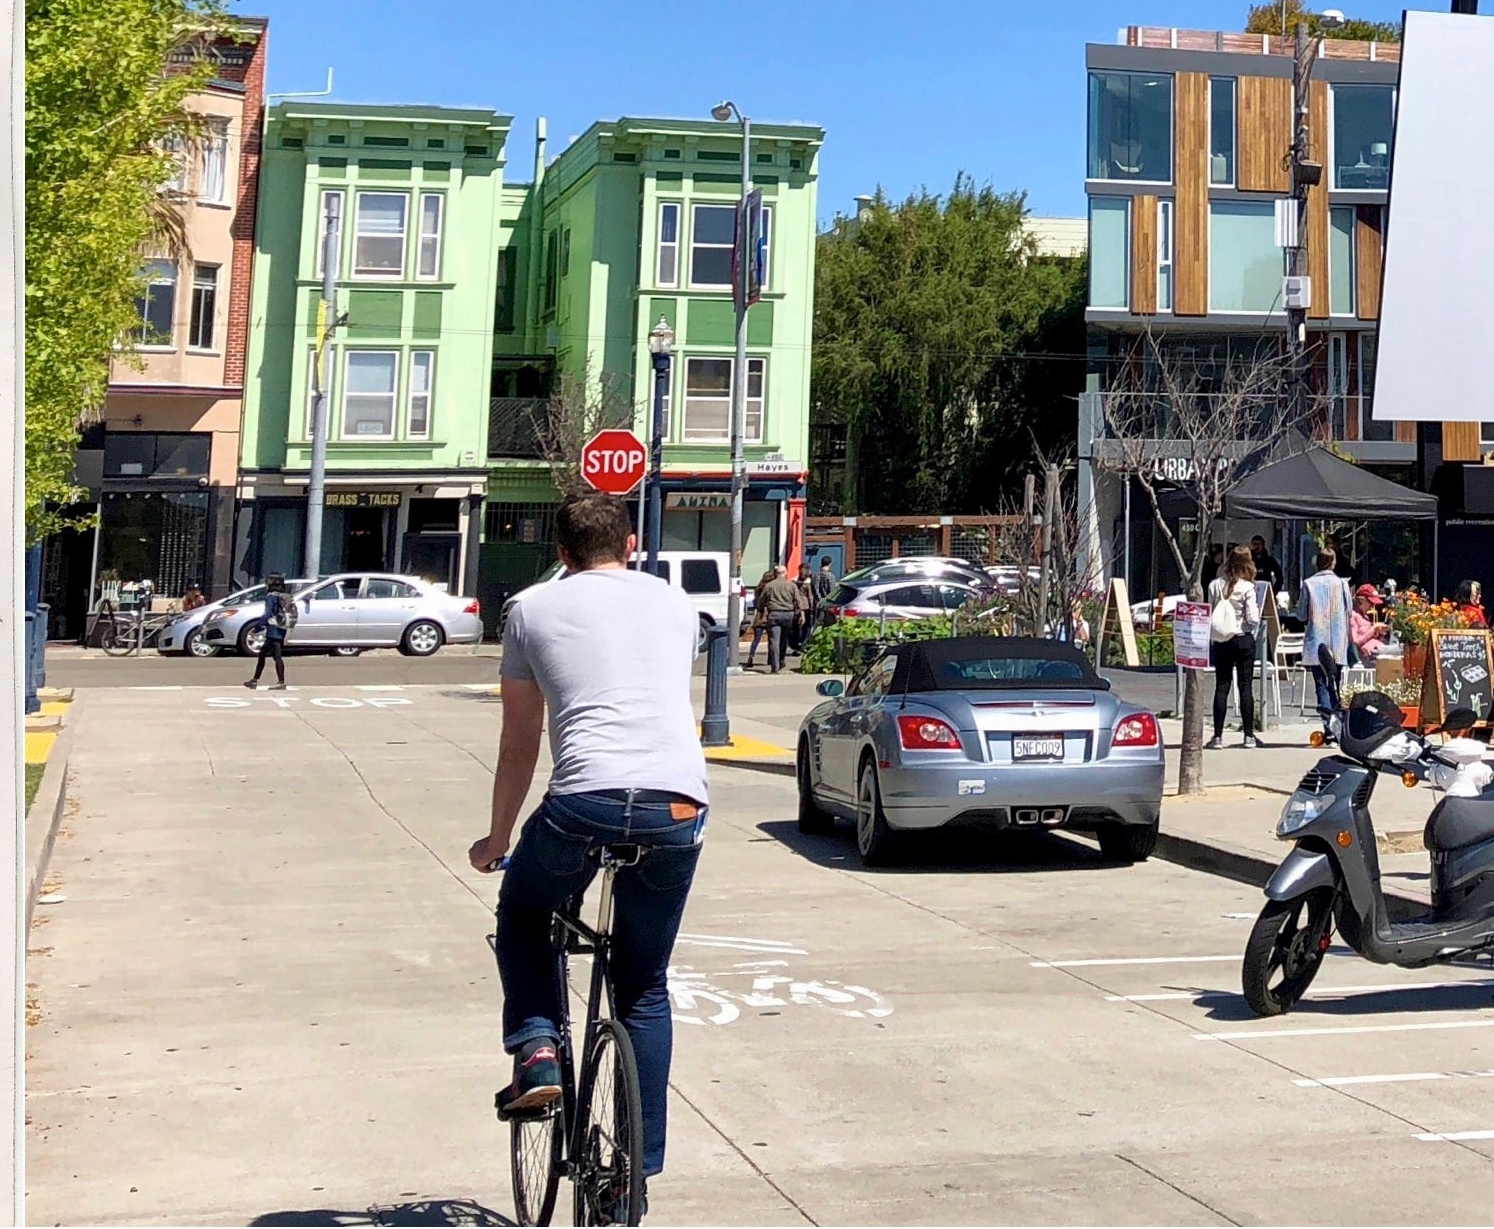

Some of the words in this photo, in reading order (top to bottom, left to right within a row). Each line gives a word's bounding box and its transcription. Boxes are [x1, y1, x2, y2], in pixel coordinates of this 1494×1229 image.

[586, 449, 644, 474] STOP
[757, 464, 789, 472] Hayes
[326, 494, 358, 505] BRASS
[368, 494, 400, 506] TACKS
[203, 696, 414, 708] STOP
